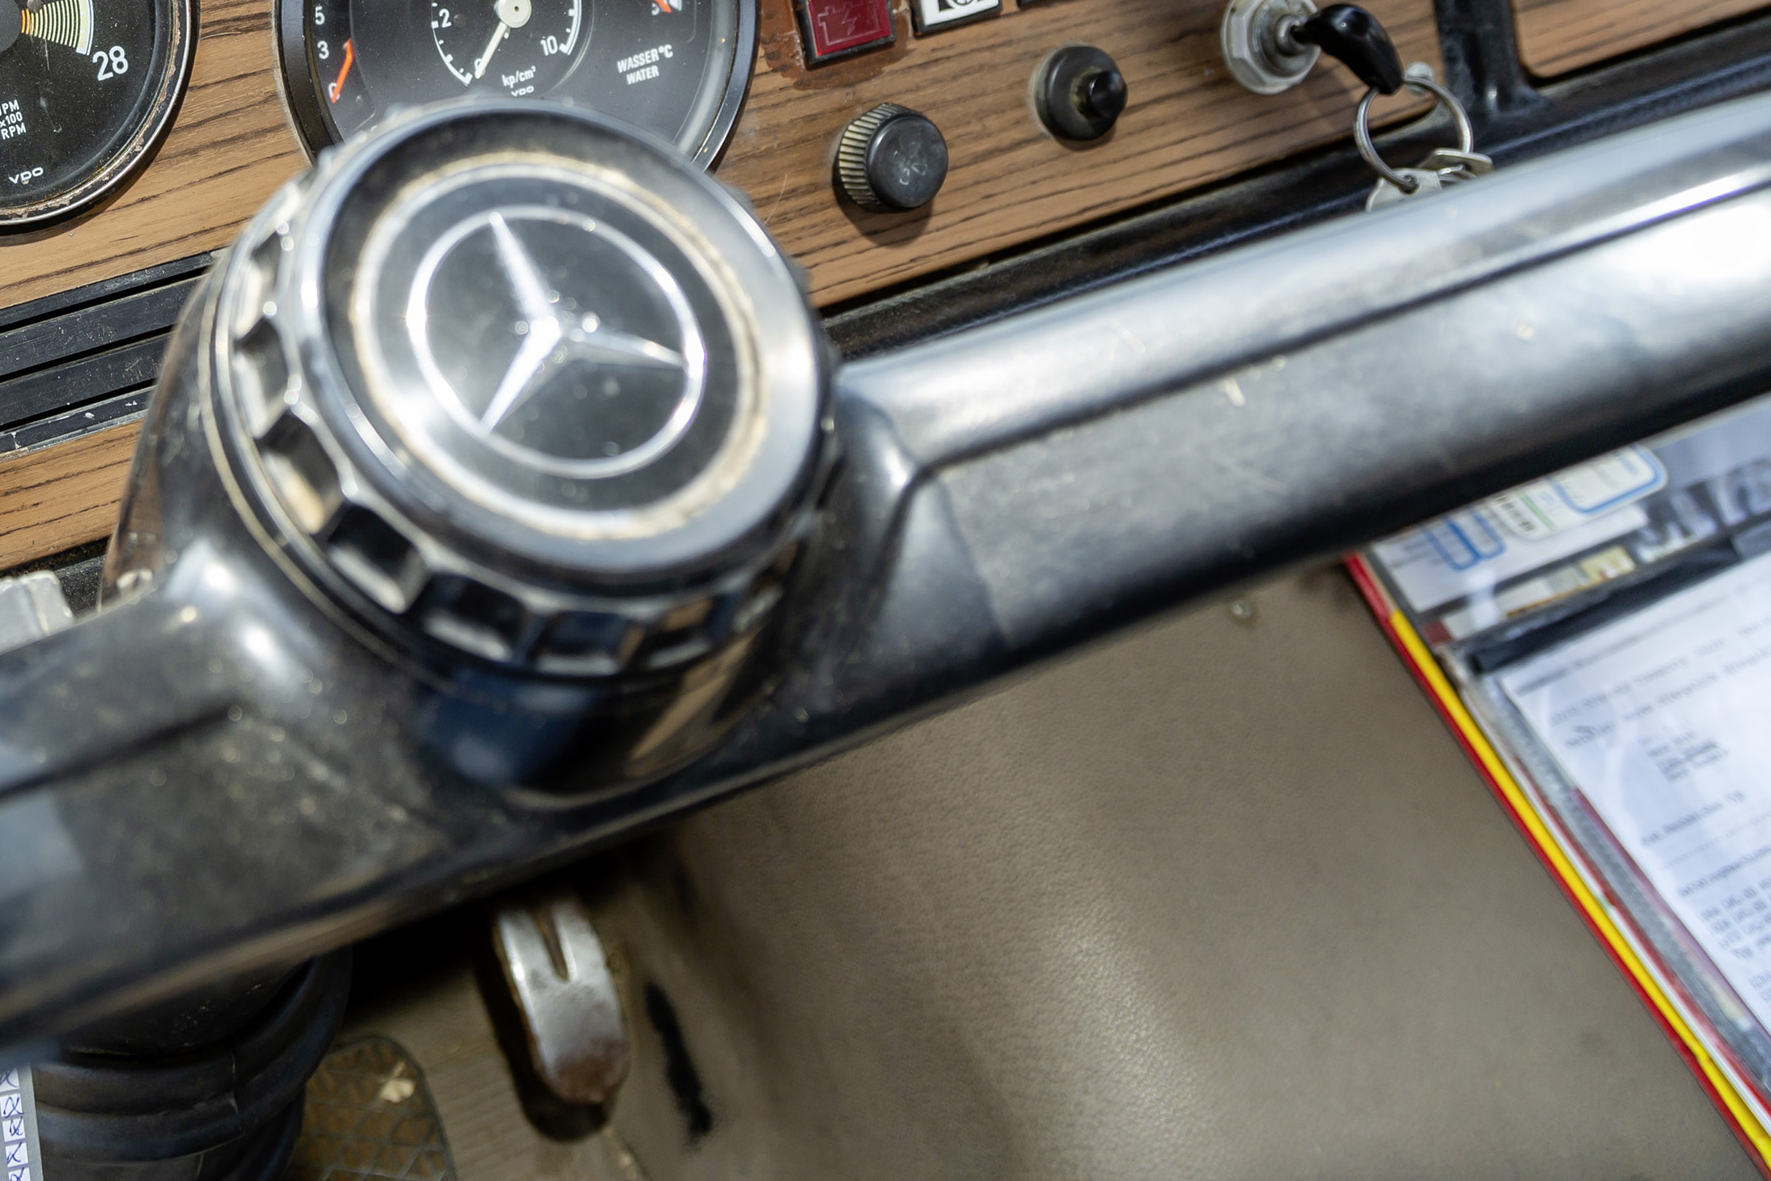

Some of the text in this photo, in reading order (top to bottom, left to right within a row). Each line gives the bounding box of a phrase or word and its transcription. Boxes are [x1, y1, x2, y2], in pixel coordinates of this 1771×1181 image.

[314, 6, 325, 25] 5
[439, 8, 452, 28] 2
[317, 40, 329, 59] 3
[540, 35, 558, 56] 10
[92, 45, 129, 82] 28
[617, 48, 659, 73] WASSER
[626, 65, 659, 85] WATER
[511, 85, 534, 97] VDO
[0, 122, 27, 140] RPM
[9, 166, 44, 184] VDO
